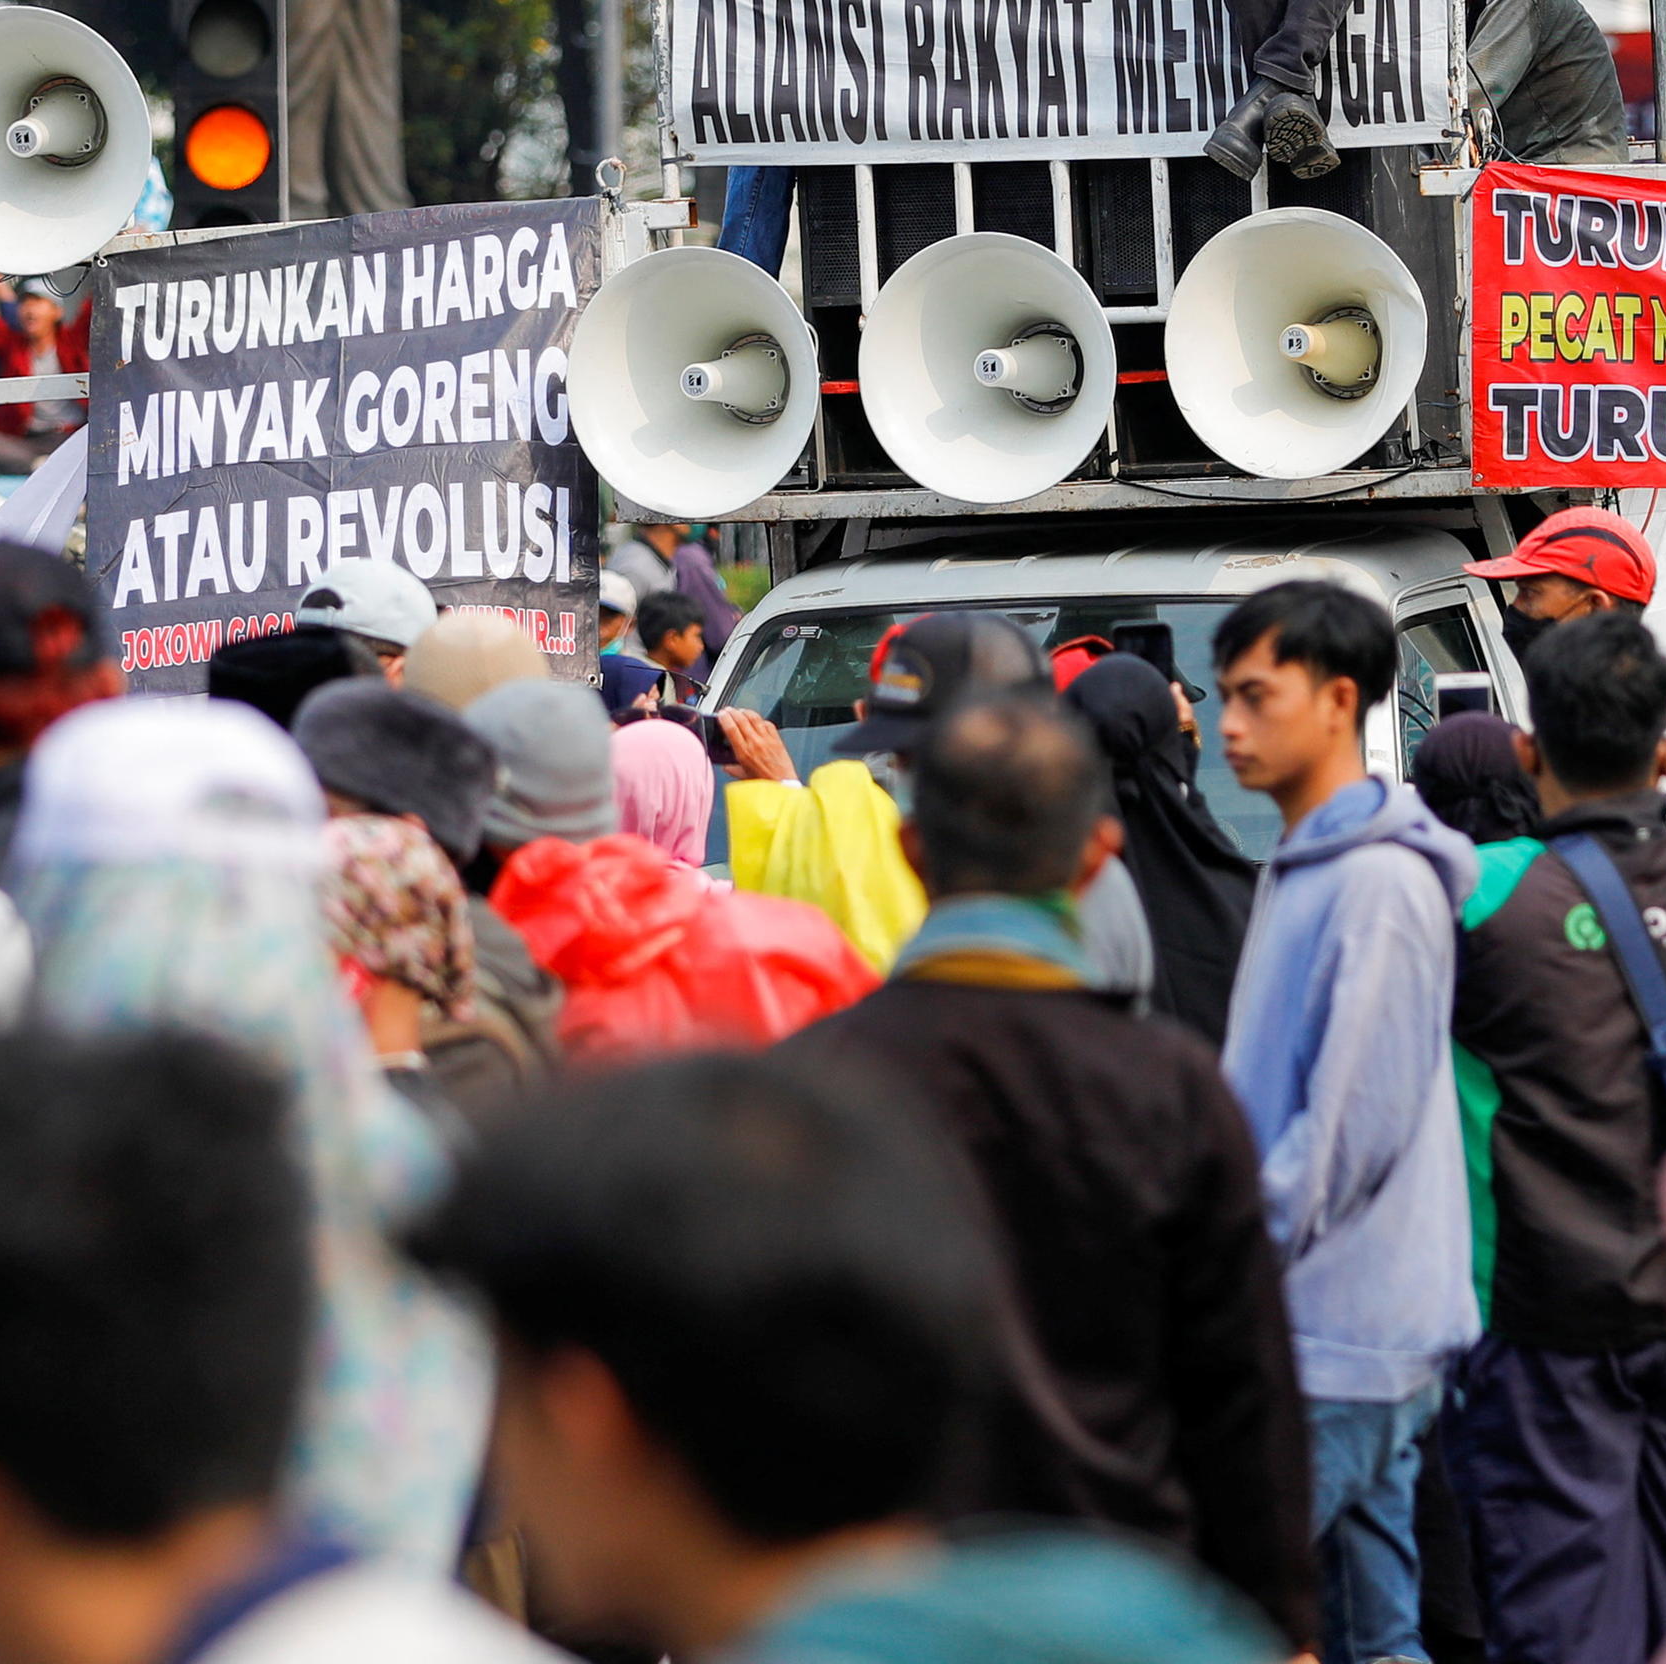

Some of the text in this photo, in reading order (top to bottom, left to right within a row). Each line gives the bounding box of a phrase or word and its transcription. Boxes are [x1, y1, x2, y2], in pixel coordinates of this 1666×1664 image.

[115, 222, 578, 365] TURUNKAN HARGA
[1500, 291, 1642, 364] PECAT
[117, 345, 570, 486] MINYAK GORENG
[113, 481, 571, 609] ATAU REVOLUSI
[121, 619, 223, 672] JOKOWI
